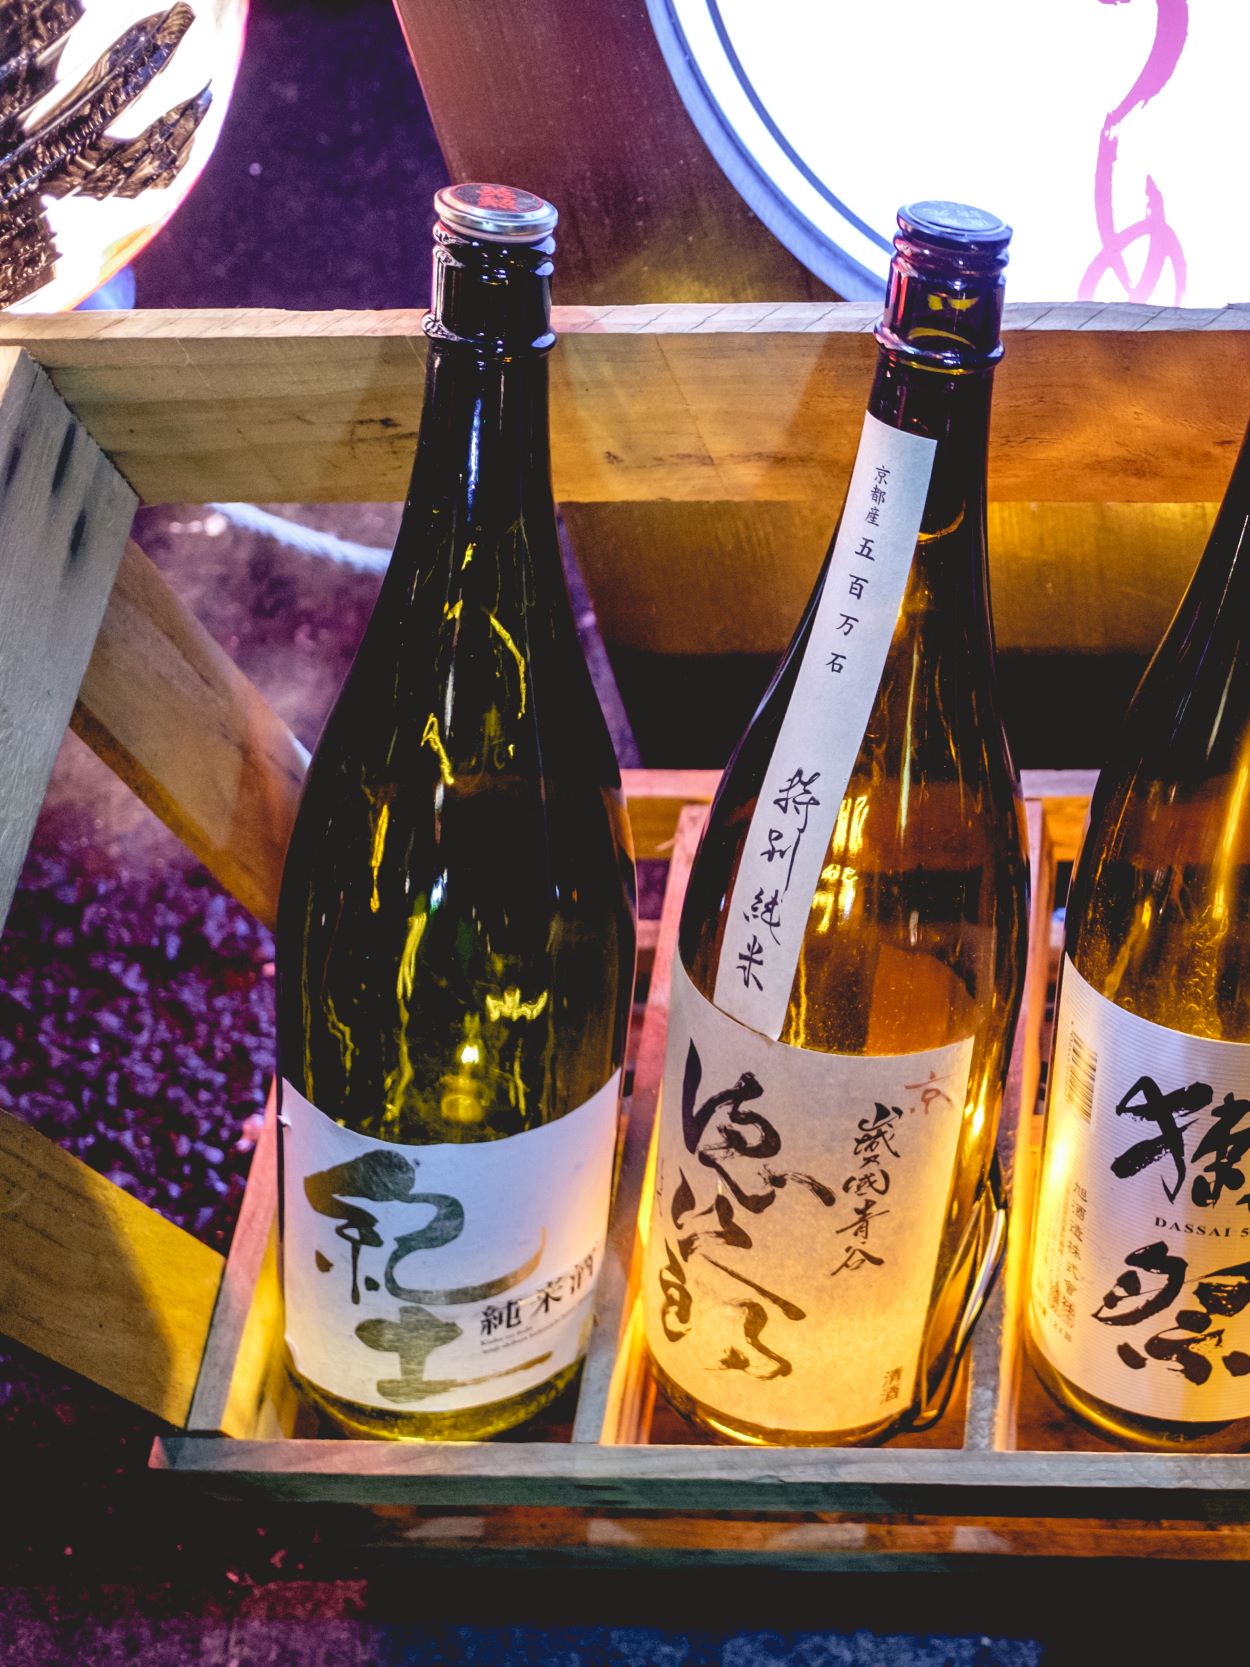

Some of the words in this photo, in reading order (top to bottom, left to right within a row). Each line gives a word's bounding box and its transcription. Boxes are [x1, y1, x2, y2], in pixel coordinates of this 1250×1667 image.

[825, 465, 891, 675] 京都産五百万石
[1154, 1217, 1231, 1238] DASSAI
